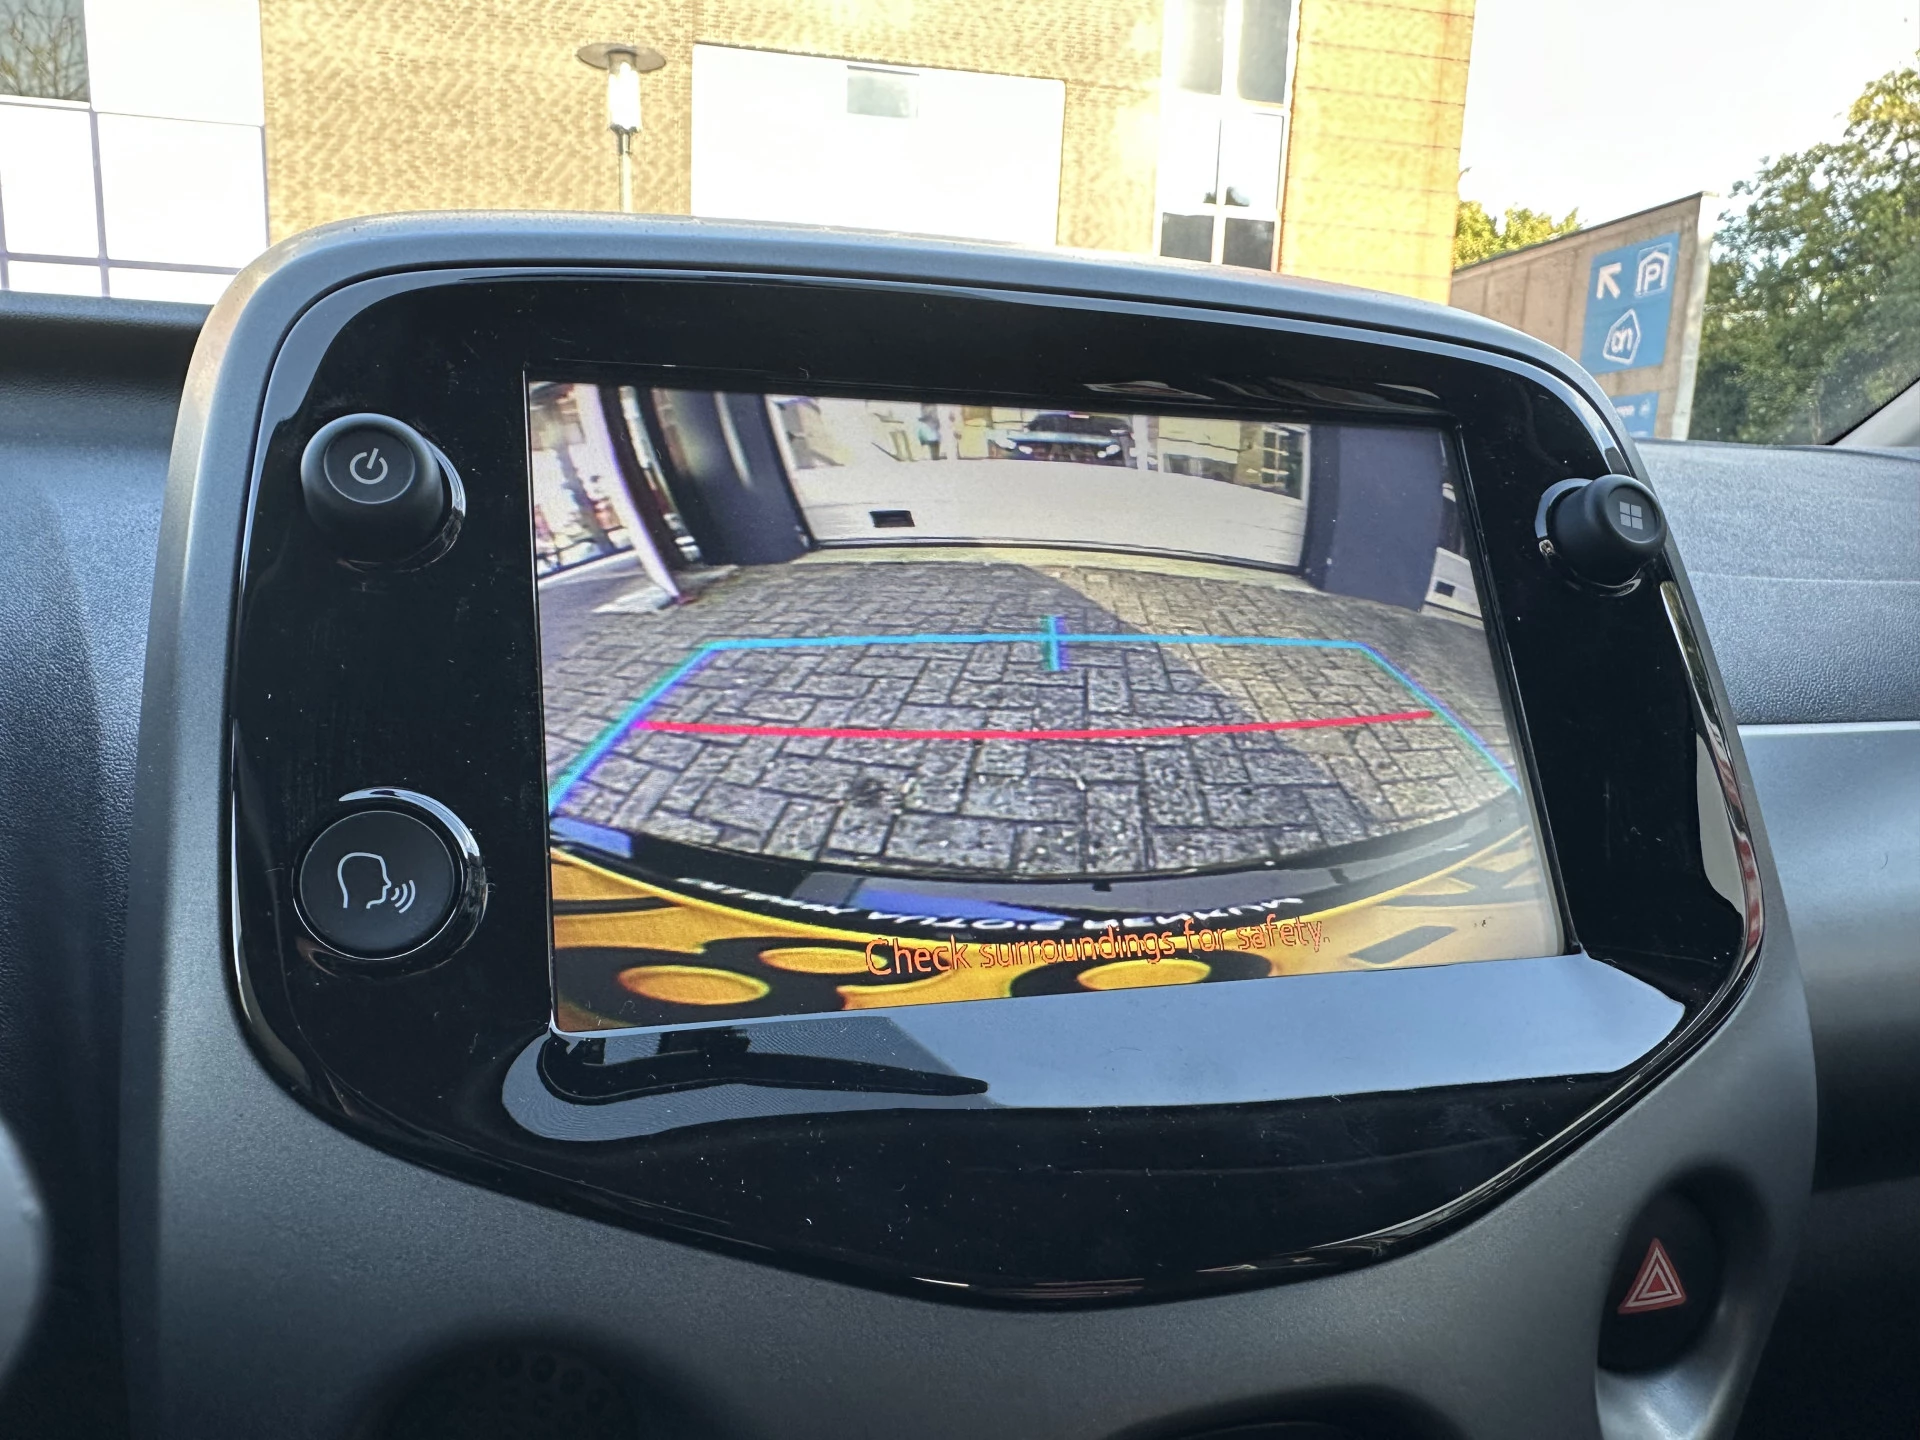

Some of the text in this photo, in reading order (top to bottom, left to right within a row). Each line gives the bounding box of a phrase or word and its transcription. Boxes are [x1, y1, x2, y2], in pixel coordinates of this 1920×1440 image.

[1643, 263, 1661, 293] P
[865, 913, 1331, 976] Check surroundings for safety.
